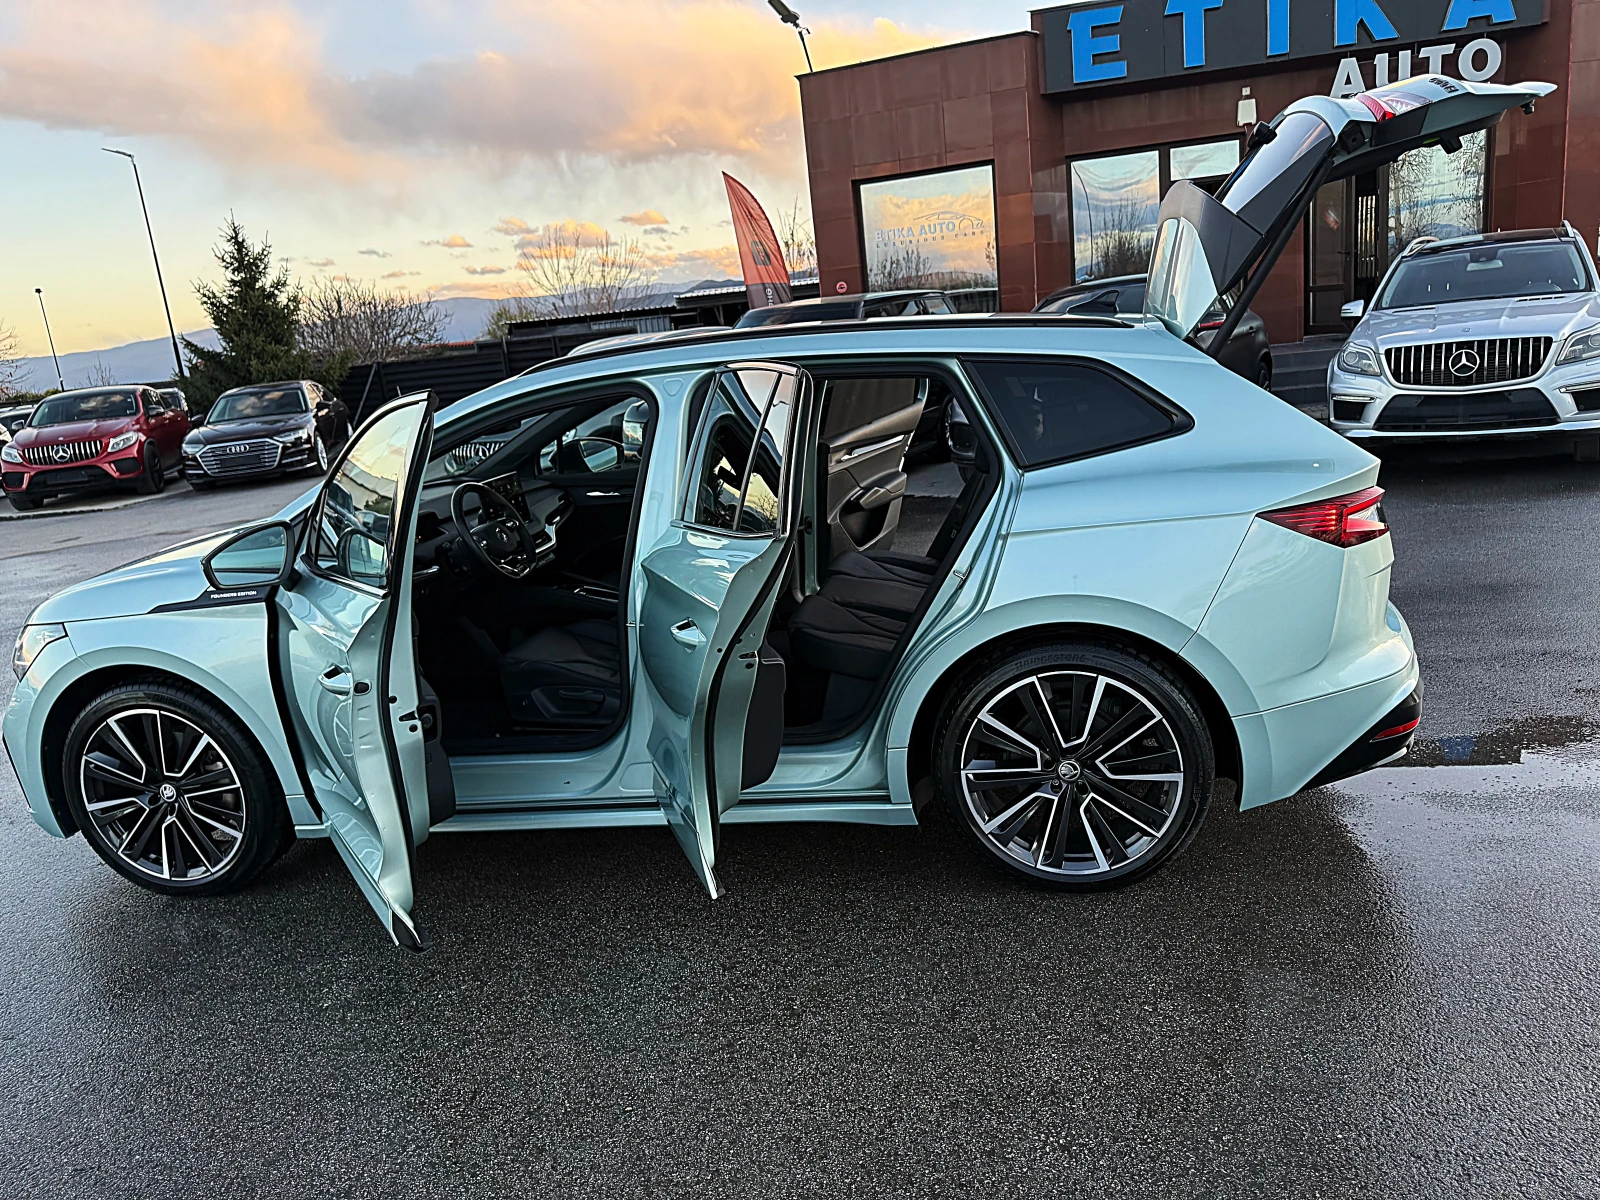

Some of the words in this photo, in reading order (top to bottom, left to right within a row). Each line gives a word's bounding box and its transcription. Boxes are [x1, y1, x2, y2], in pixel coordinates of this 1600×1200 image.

[1330, 38, 1502, 98] AUTO
[875, 226, 915, 242] ETIKA
[918, 221, 956, 237] AUTO
[876, 235, 945, 248] LUXURIOUS
[954, 230, 985, 239] CARS
